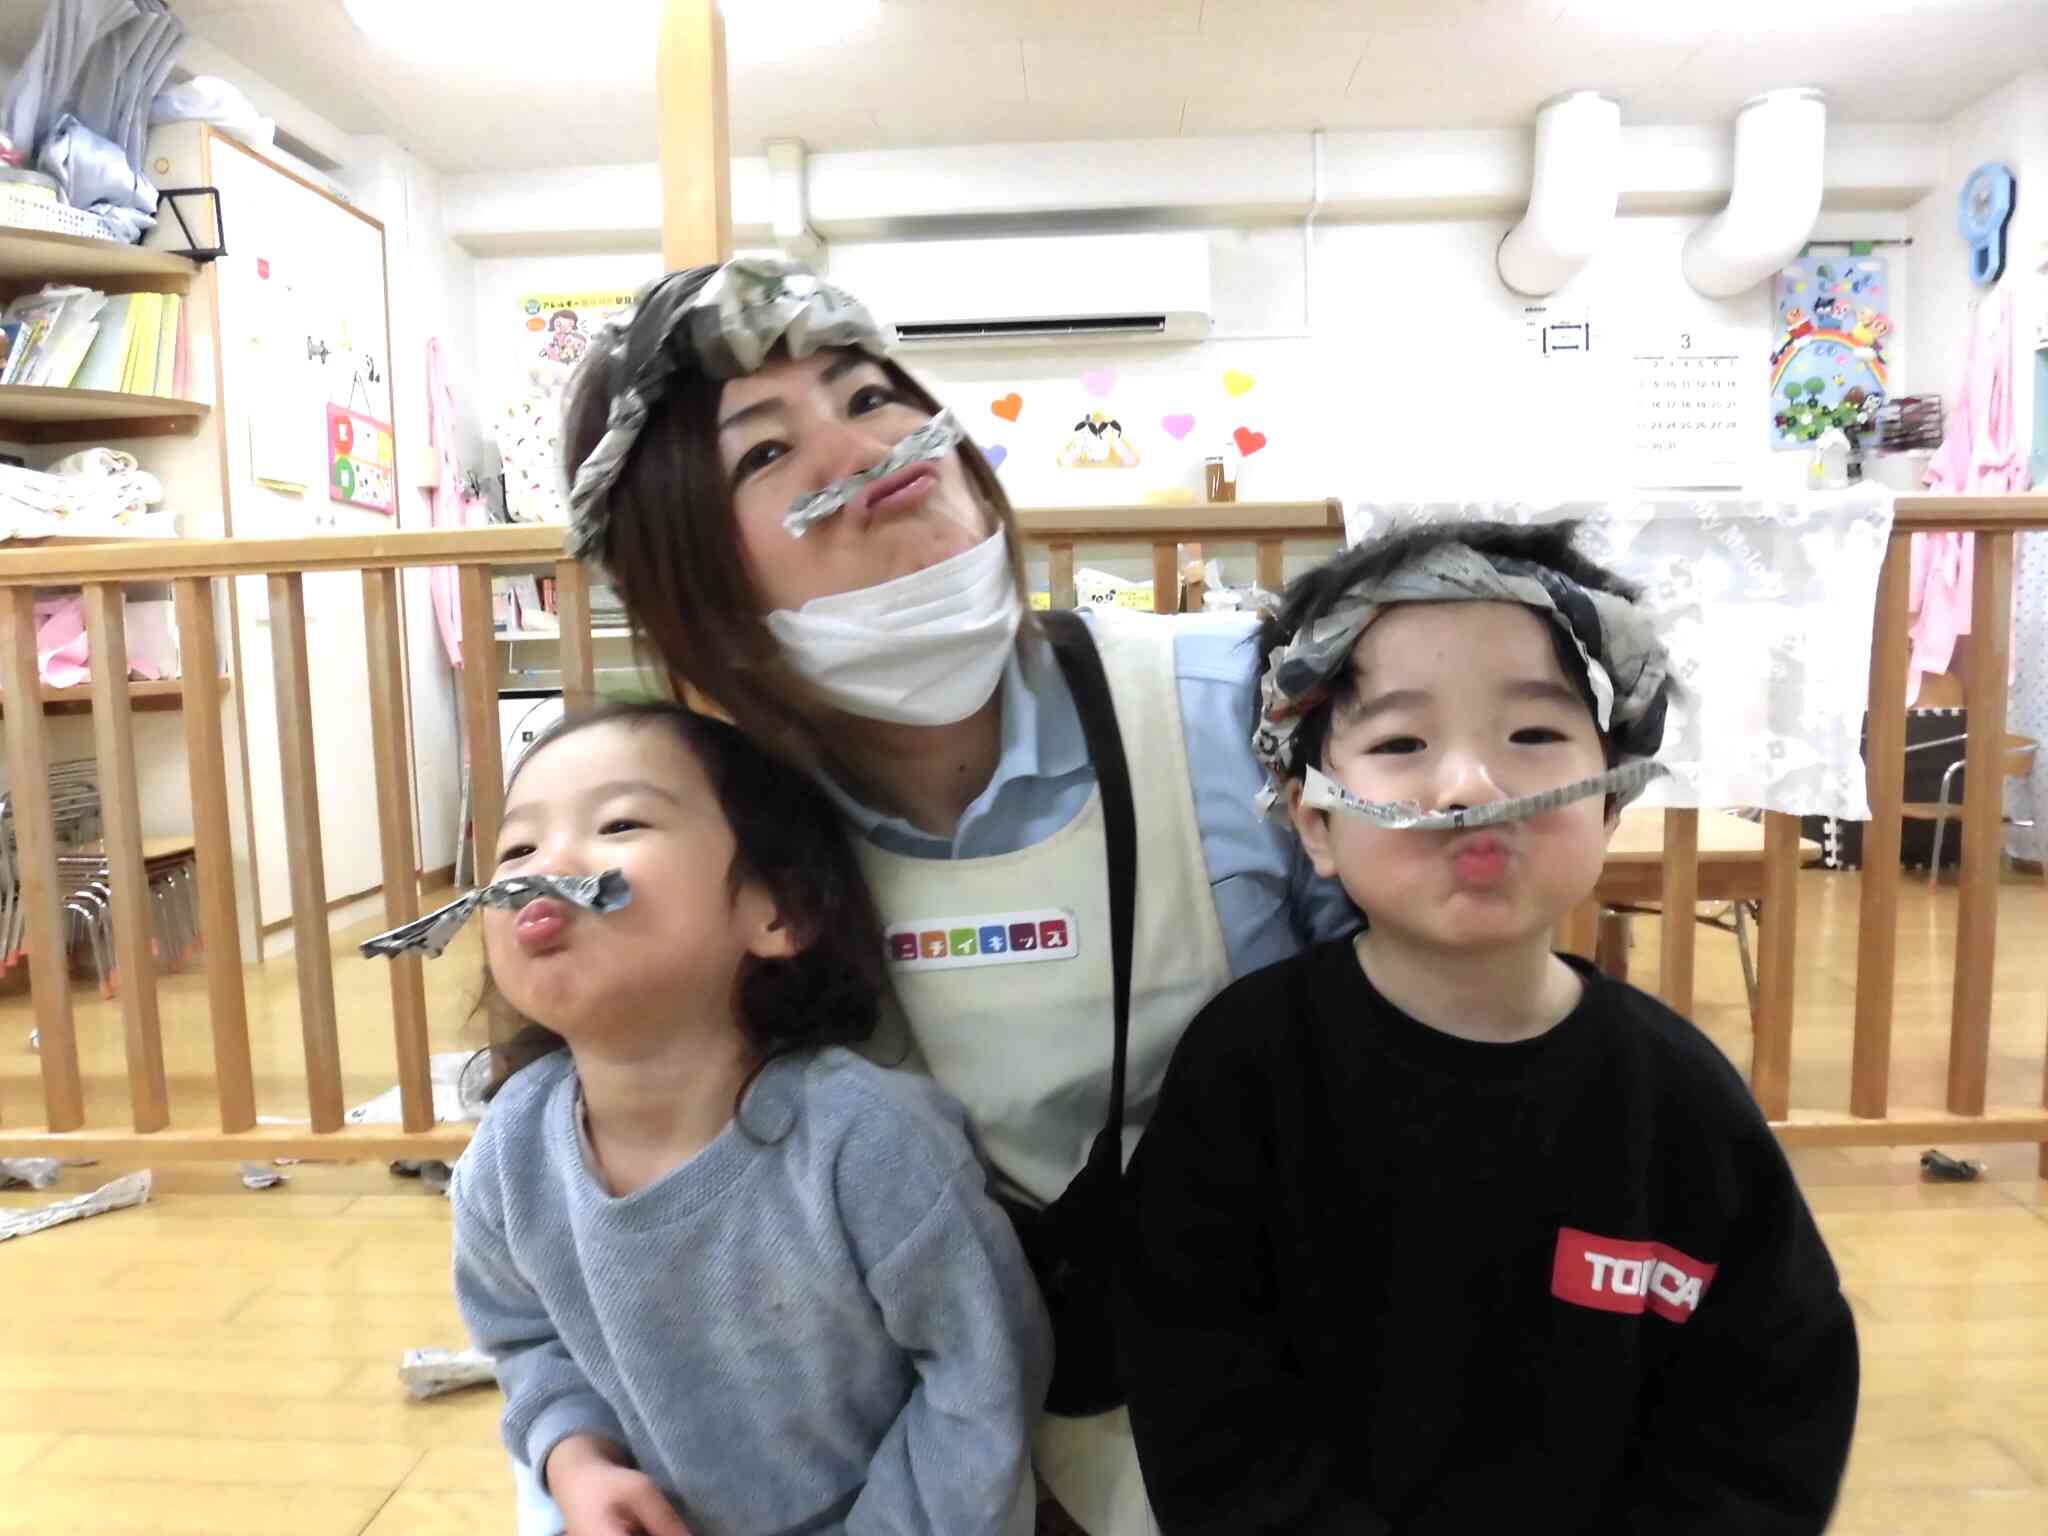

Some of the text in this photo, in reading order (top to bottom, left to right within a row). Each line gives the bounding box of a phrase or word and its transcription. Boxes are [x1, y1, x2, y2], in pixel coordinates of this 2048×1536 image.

[1680, 333, 1691, 350] 3
[897, 923, 1067, 960] ニチイキッズ
[1583, 1250, 1704, 1311] TOCA
